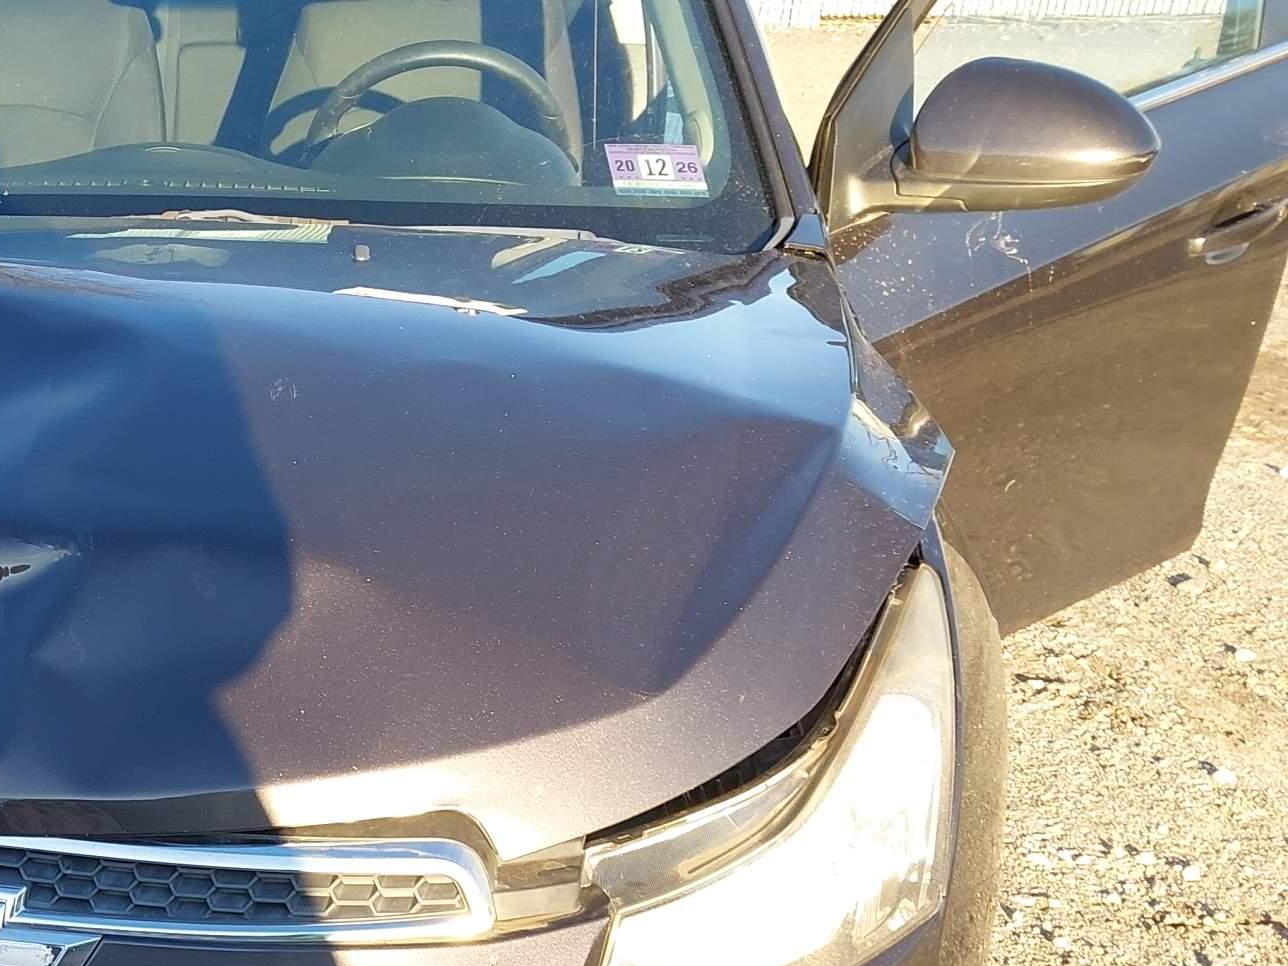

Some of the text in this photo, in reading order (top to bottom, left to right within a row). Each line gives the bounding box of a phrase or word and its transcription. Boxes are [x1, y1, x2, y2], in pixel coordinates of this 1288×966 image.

[614, 158, 698, 177] 20 12 26
